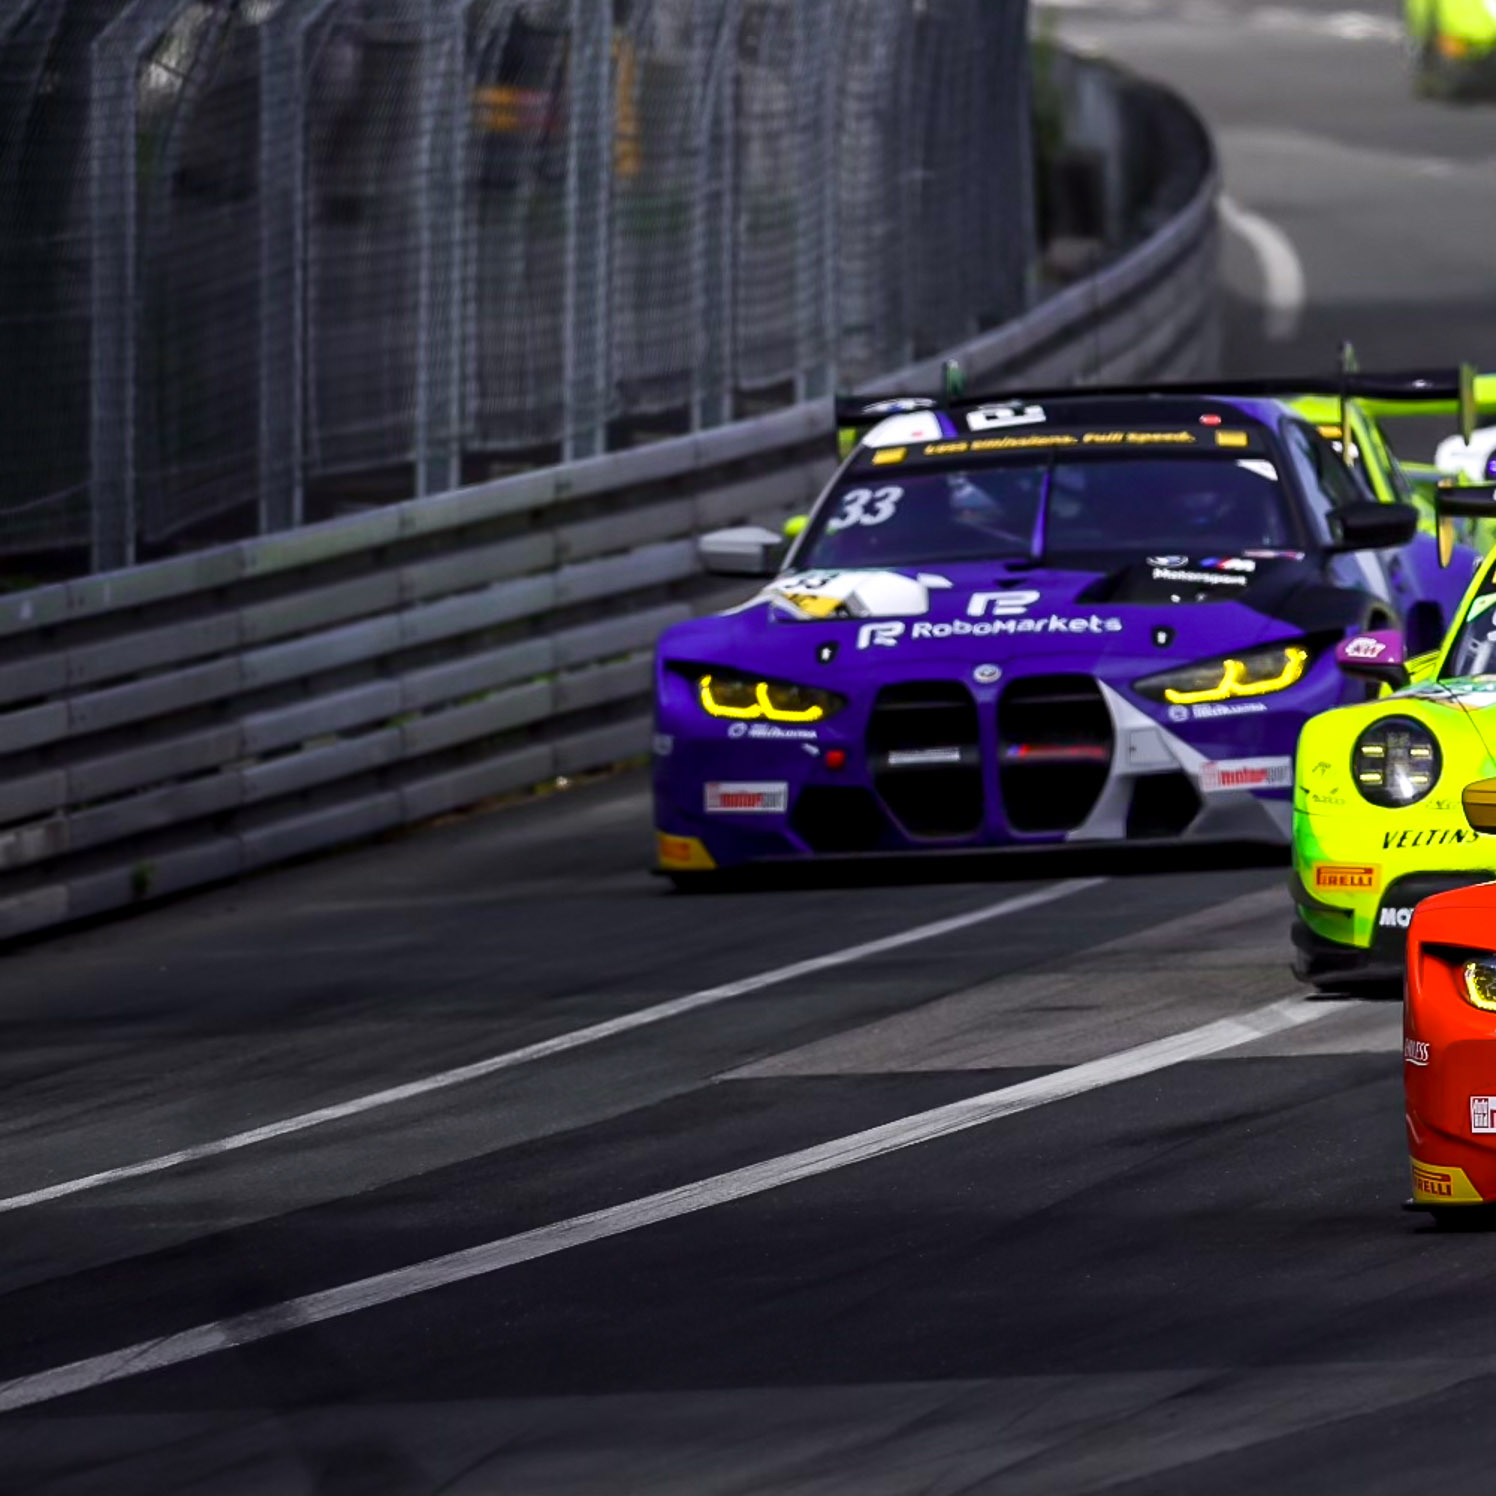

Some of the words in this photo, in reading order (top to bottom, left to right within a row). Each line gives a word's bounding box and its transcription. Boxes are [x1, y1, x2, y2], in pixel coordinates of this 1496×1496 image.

[828, 486, 904, 529] 33
[911, 613, 1123, 640] RoboMarkets
[1381, 829, 1481, 850] VELTINS
[1316, 865, 1374, 888] PIRELLI
[1378, 907, 1415, 928] MO
